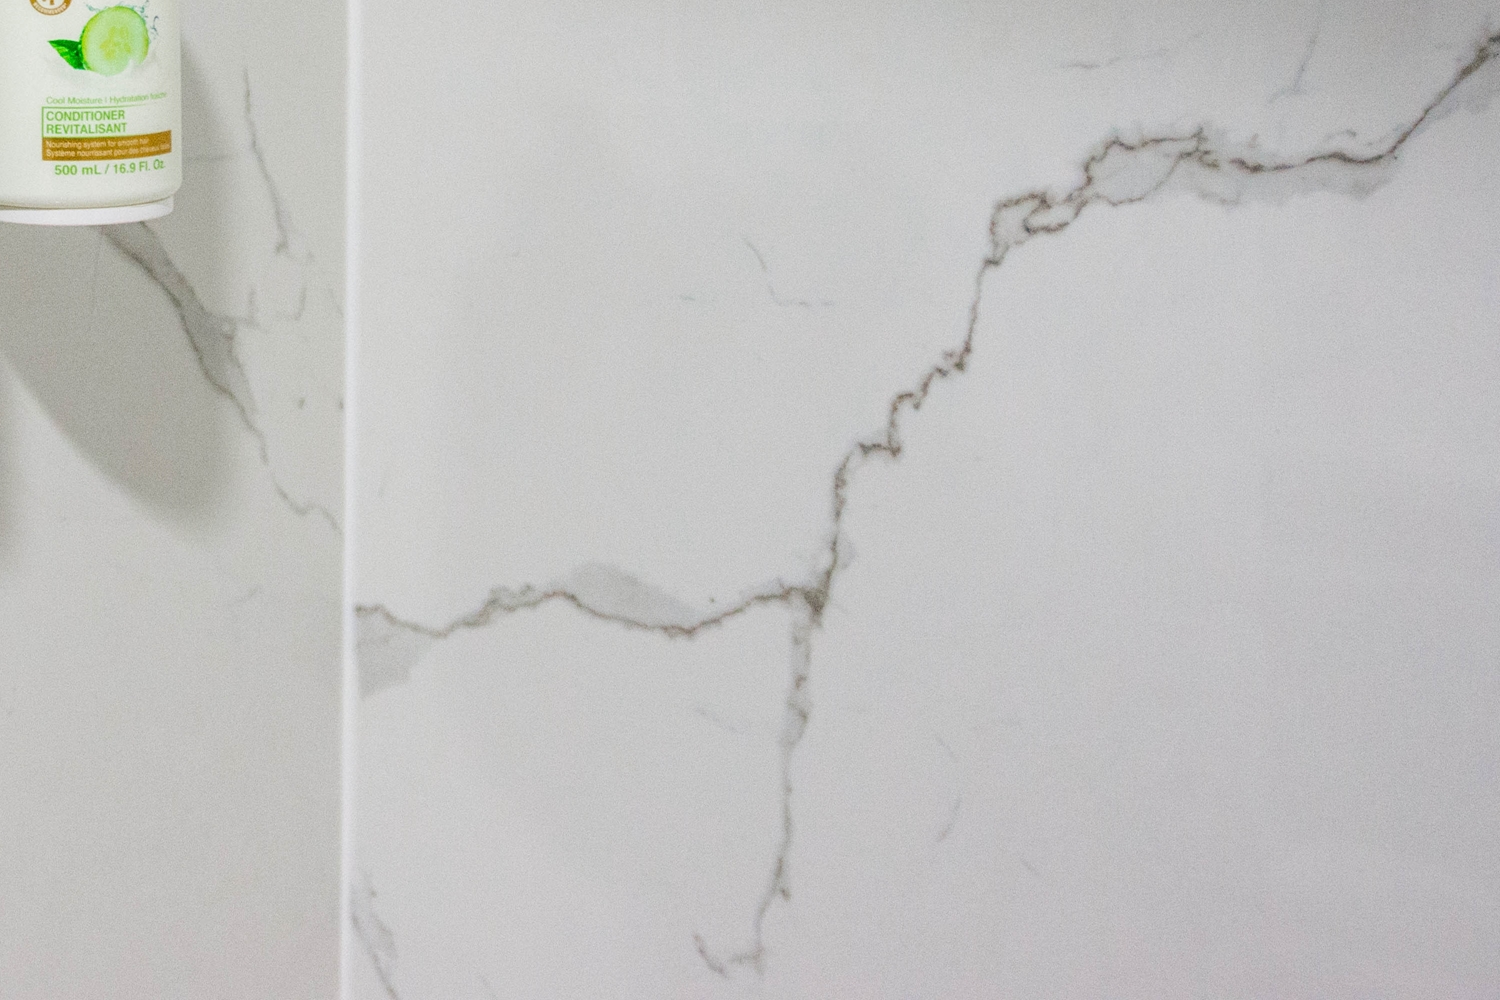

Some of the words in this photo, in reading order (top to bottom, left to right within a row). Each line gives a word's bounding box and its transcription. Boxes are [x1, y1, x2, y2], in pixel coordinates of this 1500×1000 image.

[46, 96, 65, 105] Cool
[67, 95, 101, 105] Moisture
[46, 110, 125, 121] CONDITIONER
[46, 122, 127, 134] REVITALISANT
[83, 140, 107, 149] system
[54, 164, 78, 176] 500
[81, 163, 102, 175] mL
[113, 163, 136, 174] 16.9
